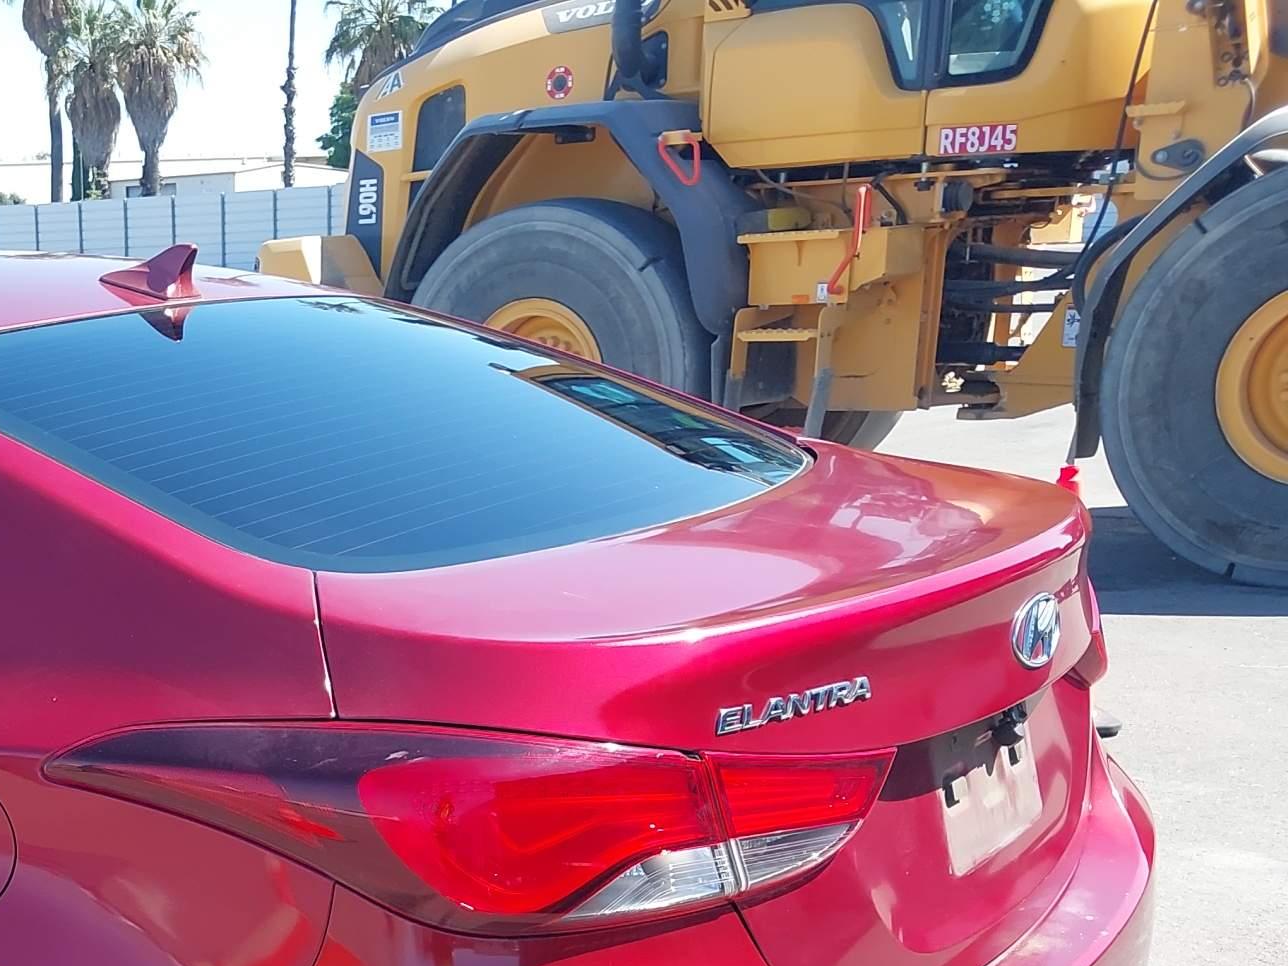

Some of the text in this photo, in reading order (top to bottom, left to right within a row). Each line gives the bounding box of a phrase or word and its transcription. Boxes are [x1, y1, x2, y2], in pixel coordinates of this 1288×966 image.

[939, 124, 1017, 154] RF8J45
[358, 178, 378, 225] L90H
[715, 676, 872, 736] ELANTRA
